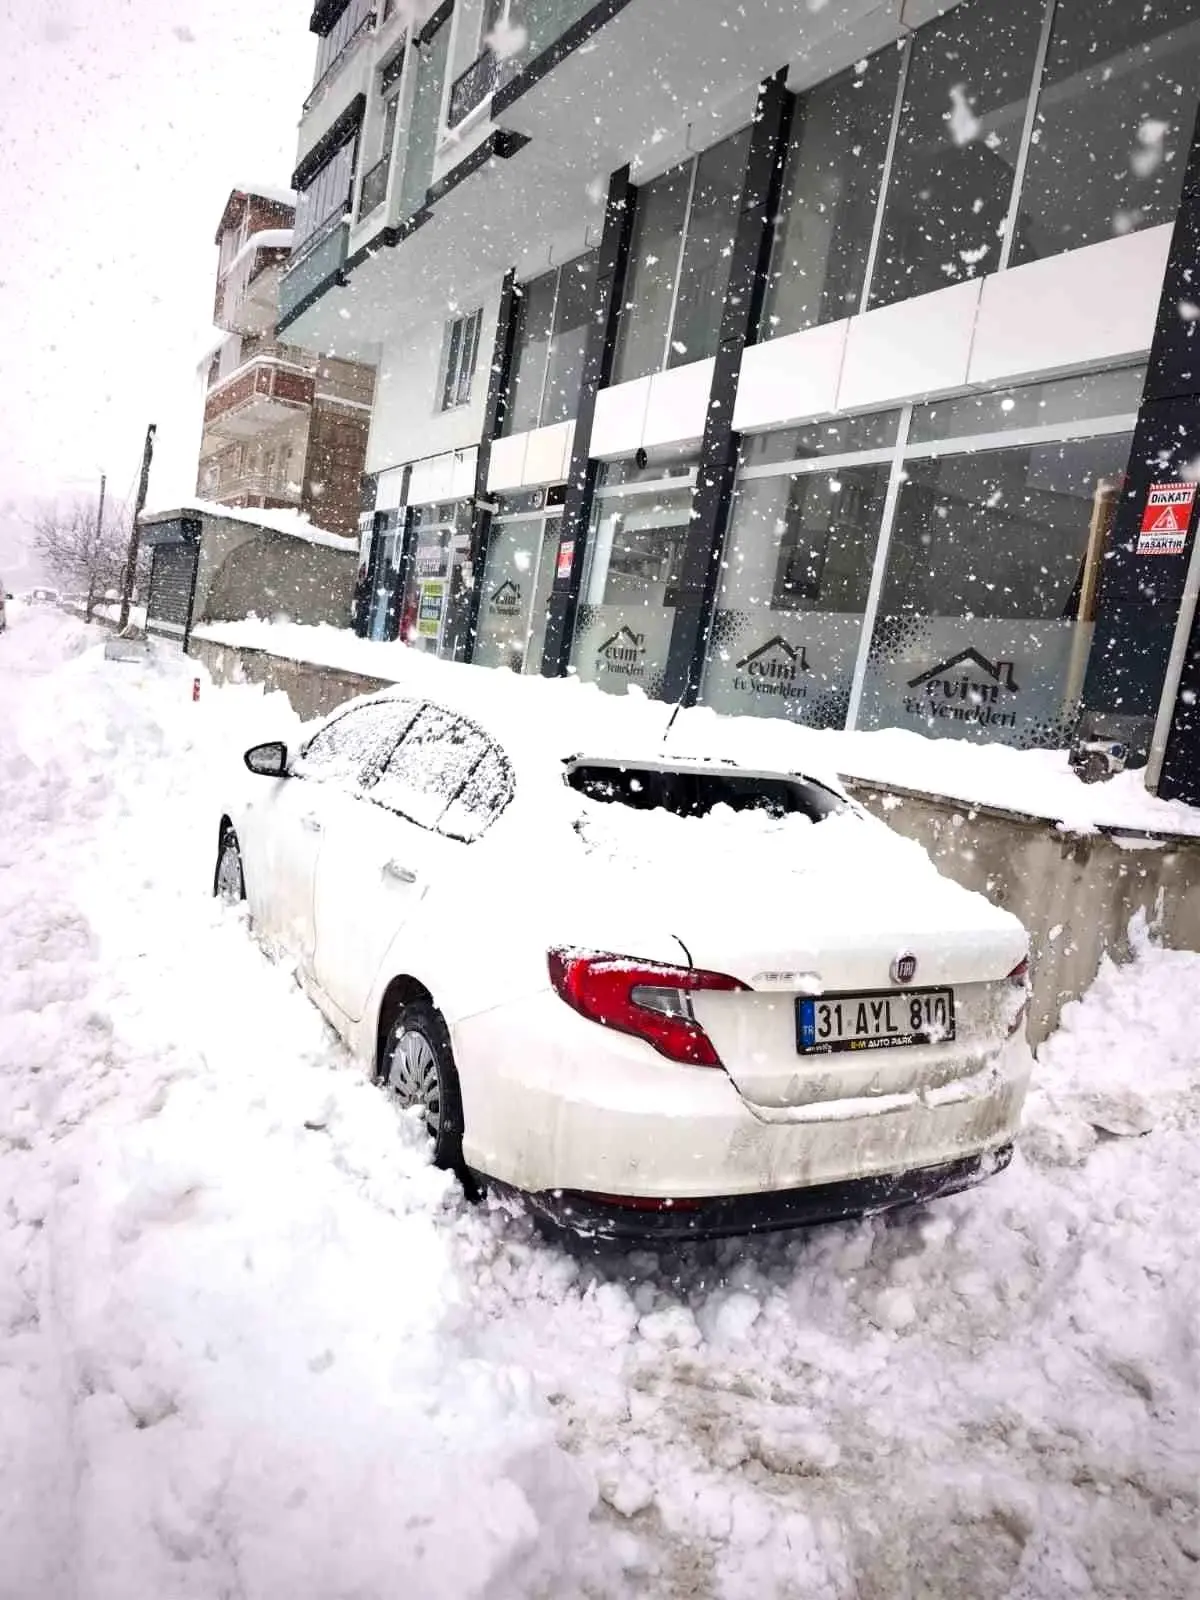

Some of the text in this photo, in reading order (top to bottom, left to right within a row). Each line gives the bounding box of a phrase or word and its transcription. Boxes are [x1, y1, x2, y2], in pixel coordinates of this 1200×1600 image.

[747, 658, 797, 681] evim
[925, 676, 1000, 704] evim
[817, 997, 947, 1038] 31 AYL 810
[867, 1037, 890, 1049] AUTO
[890, 1035, 913, 1046] PARK
